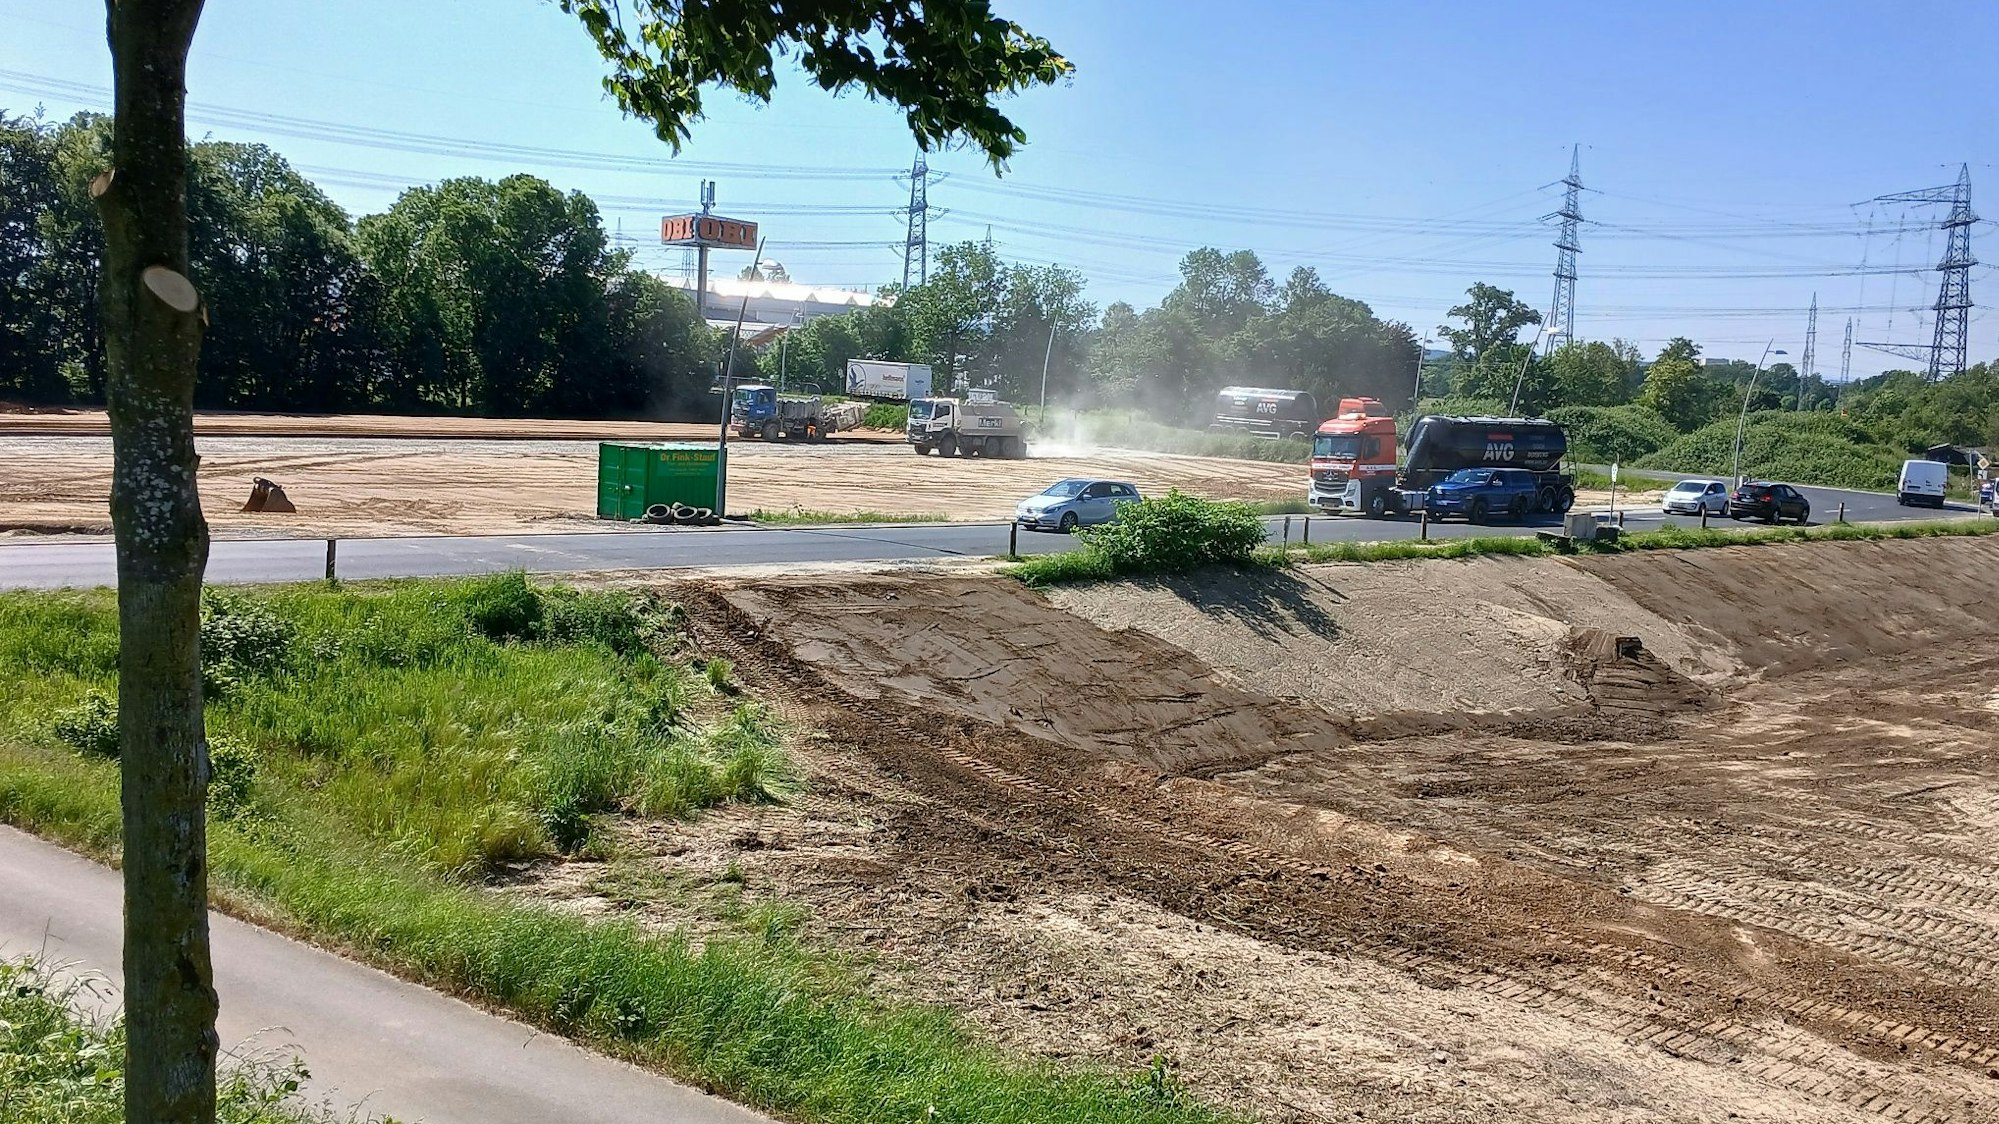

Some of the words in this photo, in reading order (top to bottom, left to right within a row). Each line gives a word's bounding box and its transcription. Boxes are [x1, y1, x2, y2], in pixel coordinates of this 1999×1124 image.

[663, 217, 693, 241] OBI
[699, 217, 755, 246] OBI
[1256, 402, 1277, 415] AVG
[1483, 443, 1515, 461] AVG
